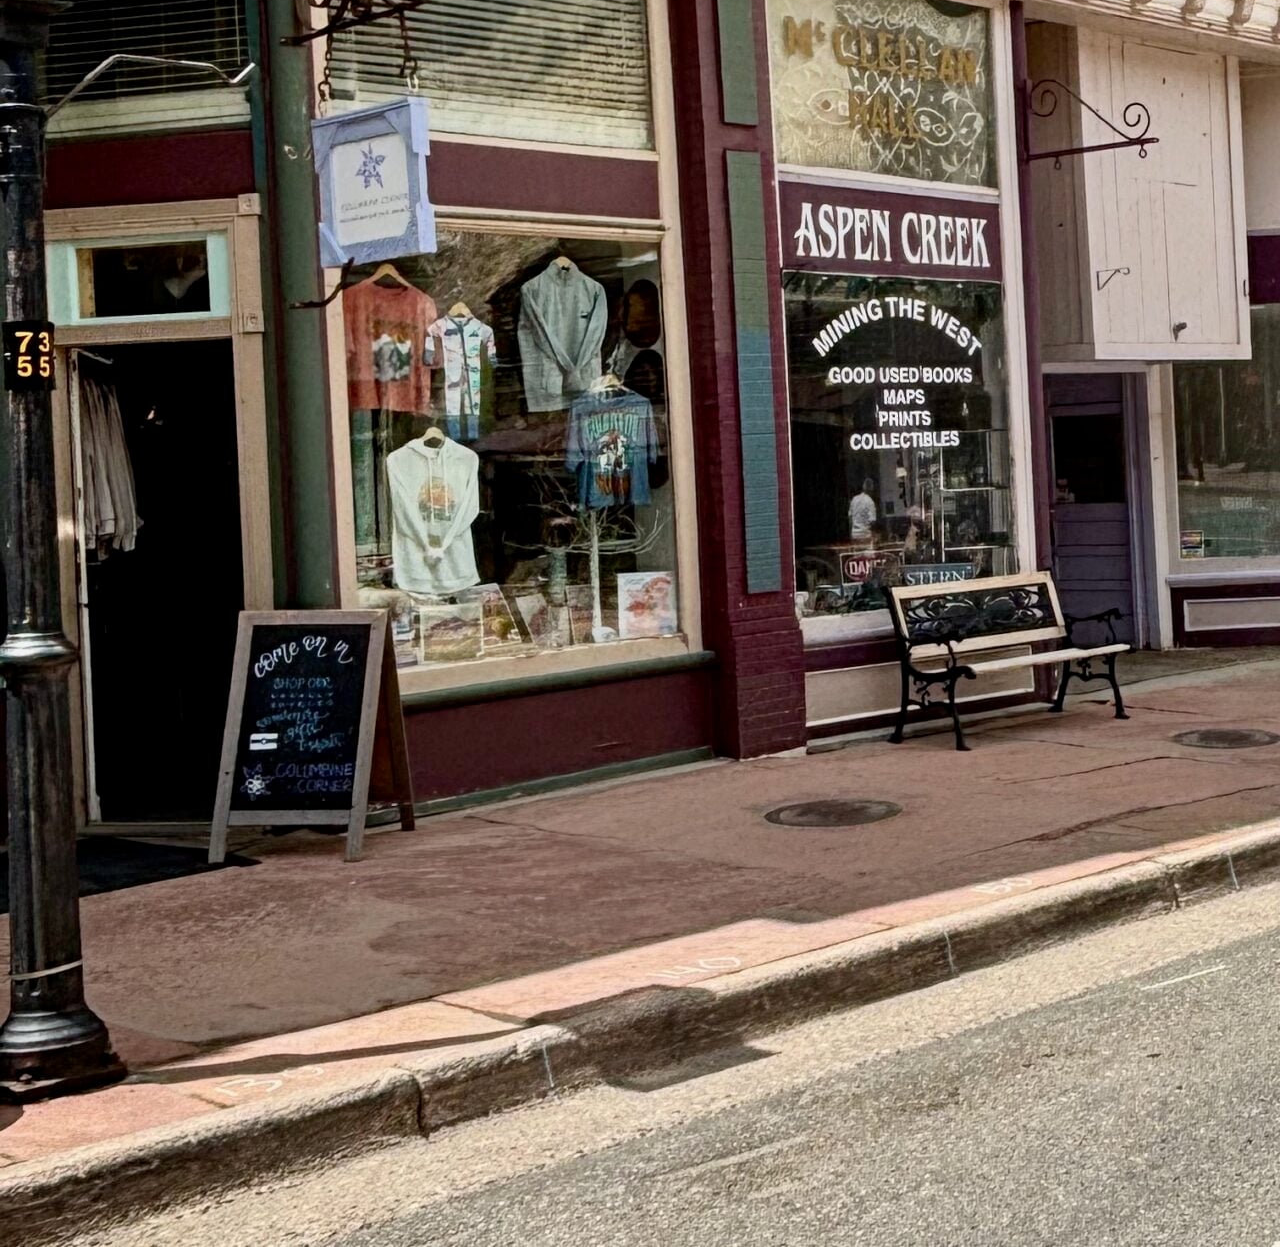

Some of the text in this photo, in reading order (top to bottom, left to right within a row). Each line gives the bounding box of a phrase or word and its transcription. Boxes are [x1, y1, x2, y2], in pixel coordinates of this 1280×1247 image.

[794, 202, 991, 268] ASPEN CREEK
[811, 296, 982, 357] MINING THE WEST
[828, 366, 973, 385] GOOD USED BOOKS
[883, 389, 926, 405] MAPS
[878, 410, 932, 427] PRINTS
[850, 430, 961, 451] COLLECTIBLES
[254, 642, 300, 679] come
